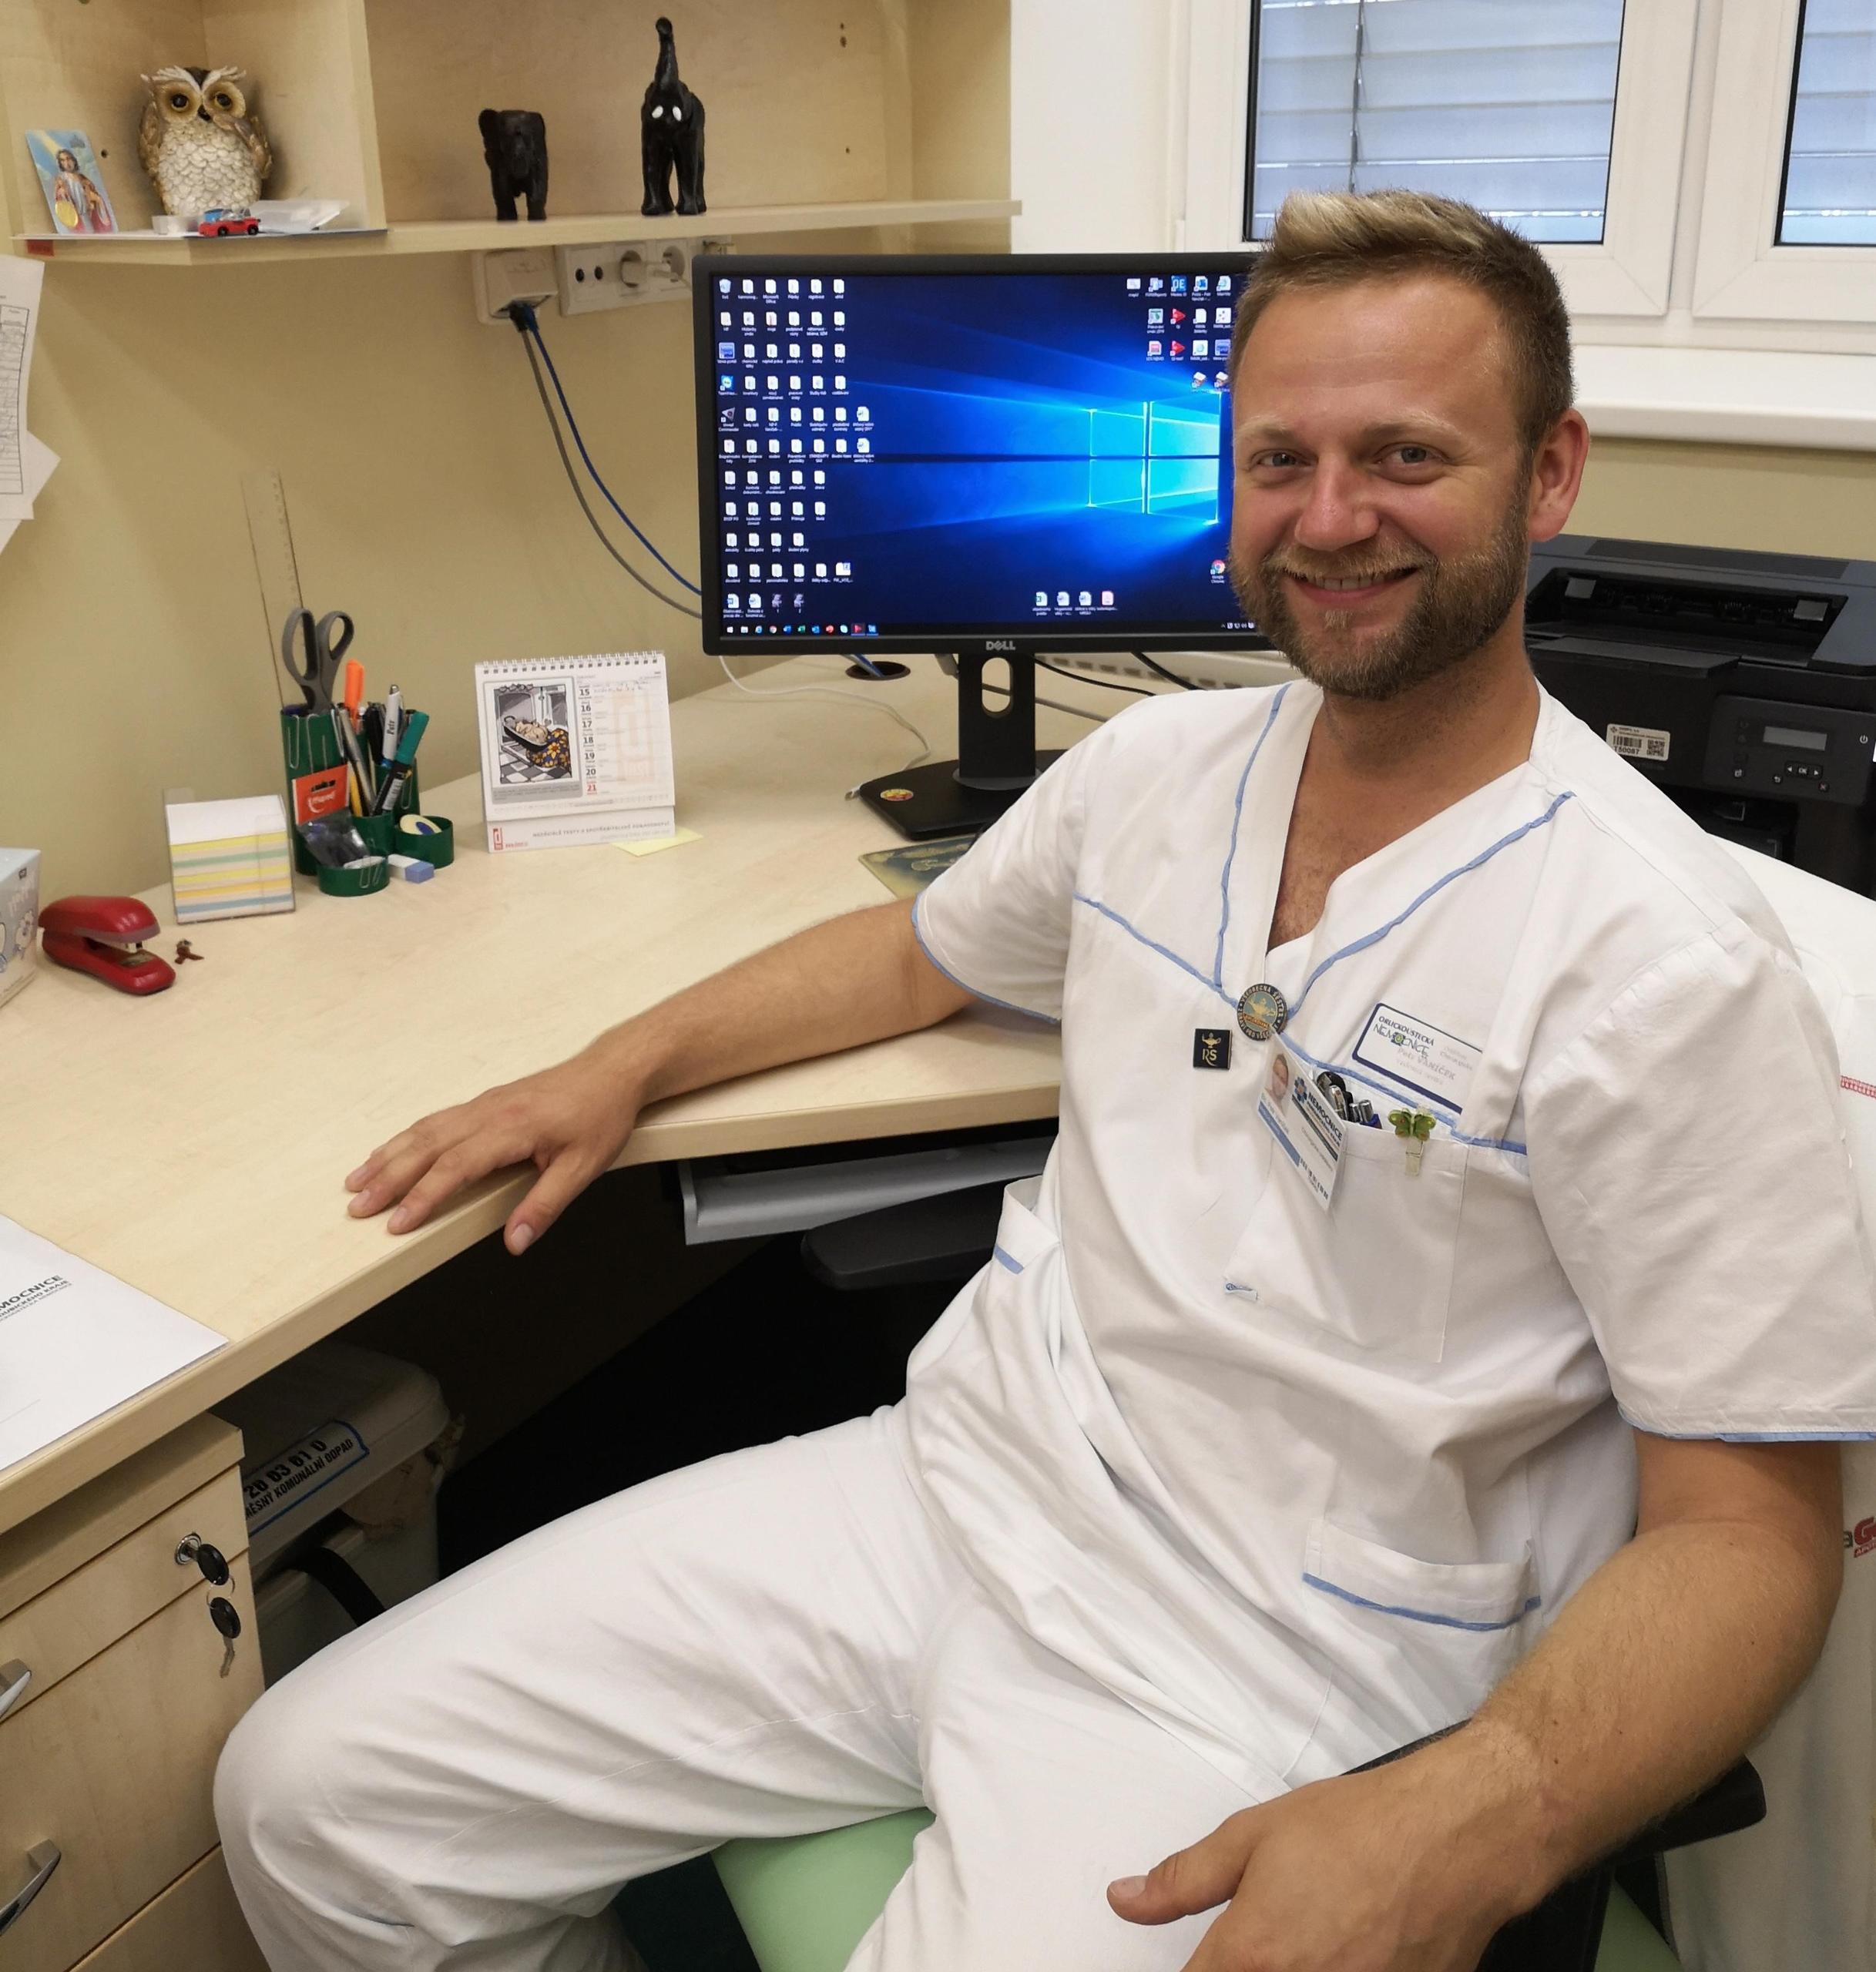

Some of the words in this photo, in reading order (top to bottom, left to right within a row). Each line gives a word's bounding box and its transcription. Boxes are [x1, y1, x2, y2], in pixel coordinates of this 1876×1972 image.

[985, 640, 1016, 651] DELL
[581, 704, 592, 713] 16
[582, 720, 592, 729] 17
[583, 736, 594, 745] 18
[584, 752, 595, 760] 19
[586, 768, 596, 776] 20
[587, 783, 597, 792] 21
[1307, 1092, 1343, 1141] NEMOCNICE
[274, 1457, 325, 1498] KOMUNÁLNÍ
[324, 1438, 354, 1464] ODPAD
